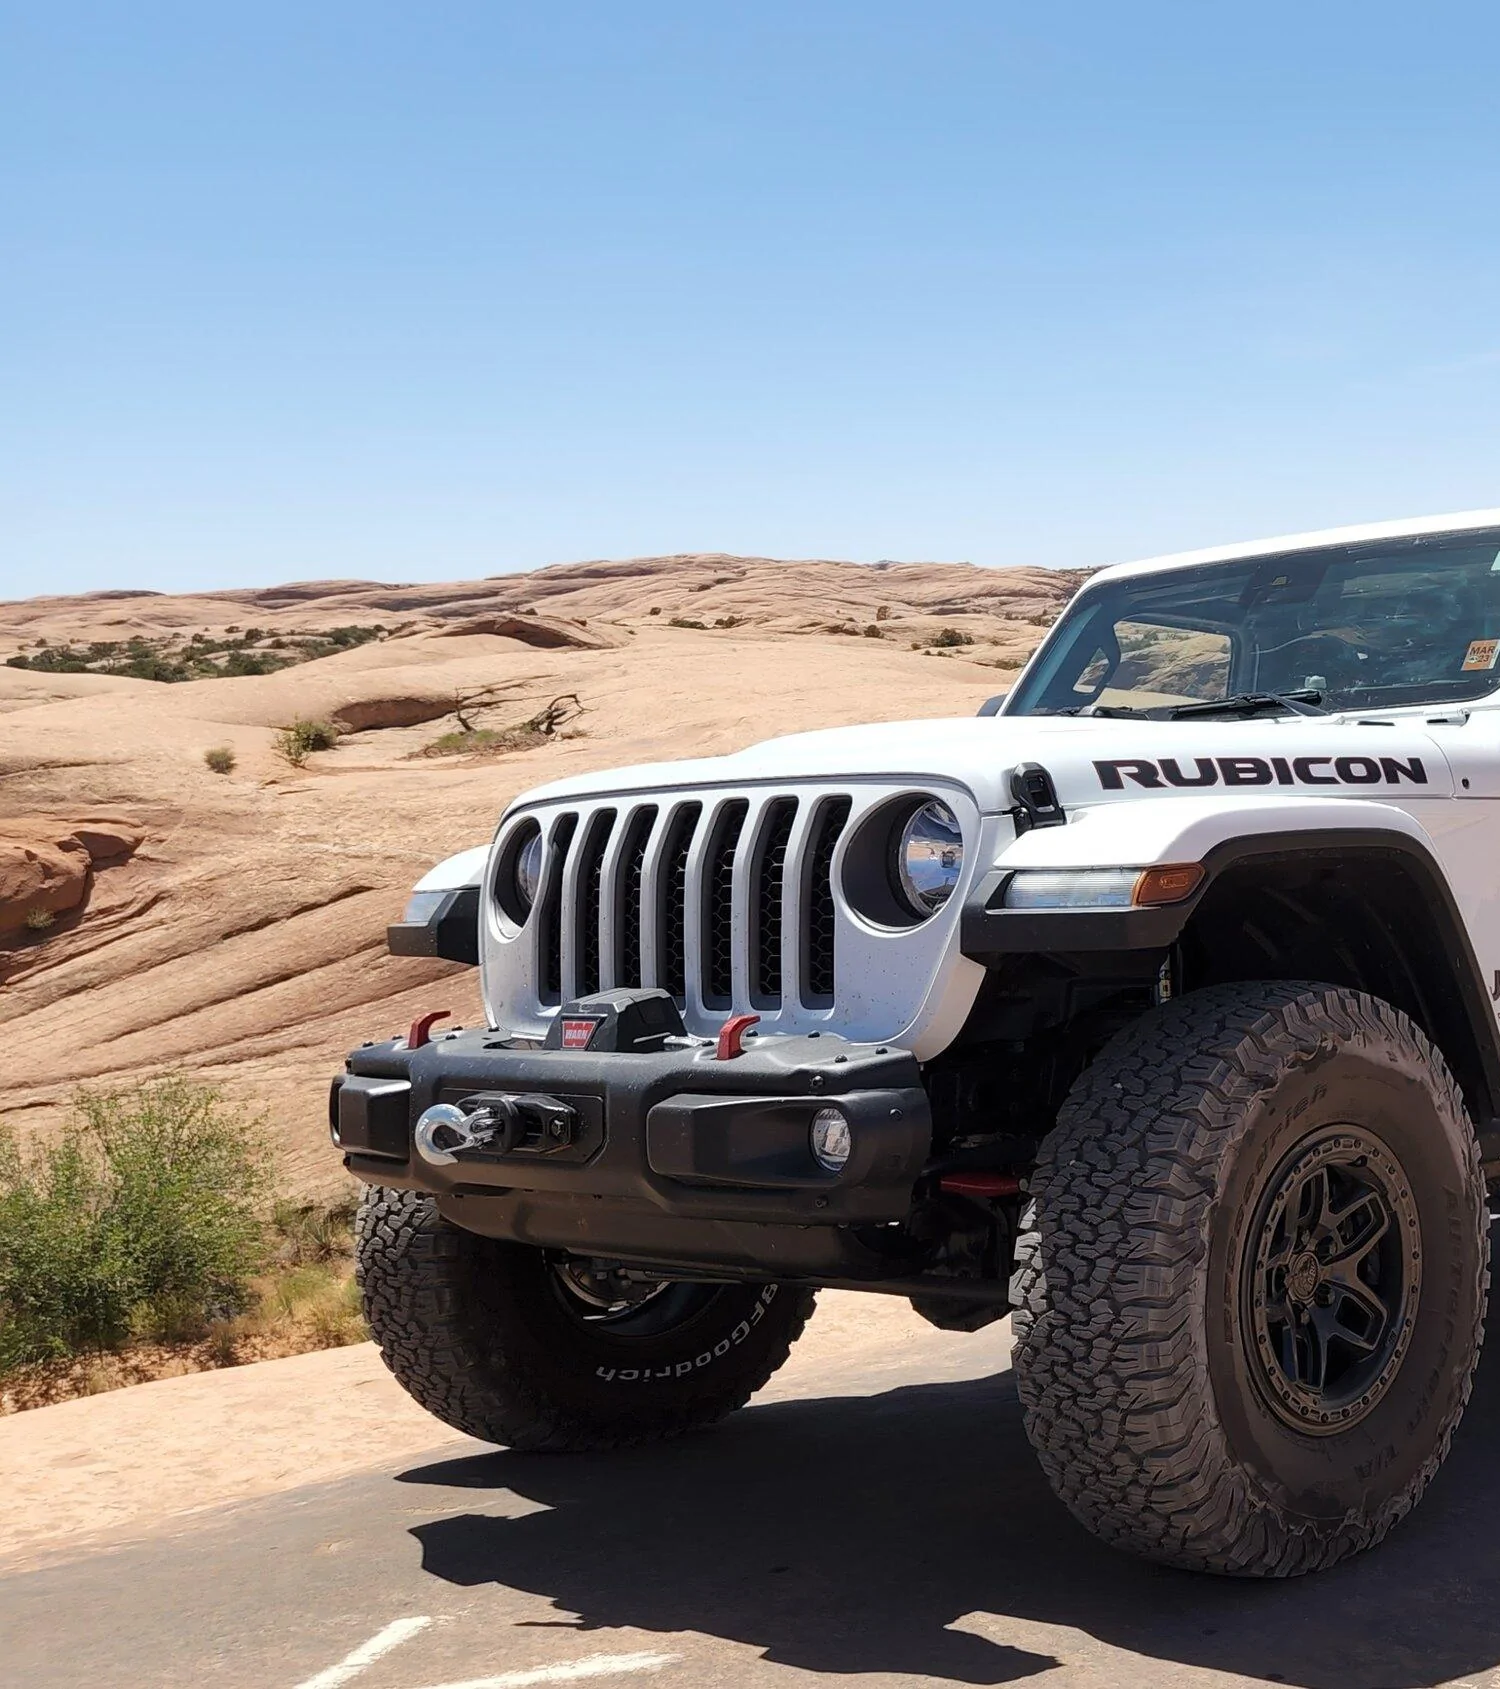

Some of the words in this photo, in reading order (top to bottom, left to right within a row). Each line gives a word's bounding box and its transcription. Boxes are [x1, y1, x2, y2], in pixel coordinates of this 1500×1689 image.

[1470, 646, 1496, 655] MAR
[1477, 655, 1490, 663] 23
[1092, 757, 1428, 790] RUBICON
[565, 1029, 588, 1039] WARN
[596, 1283, 779, 1383] BFGoodrich
